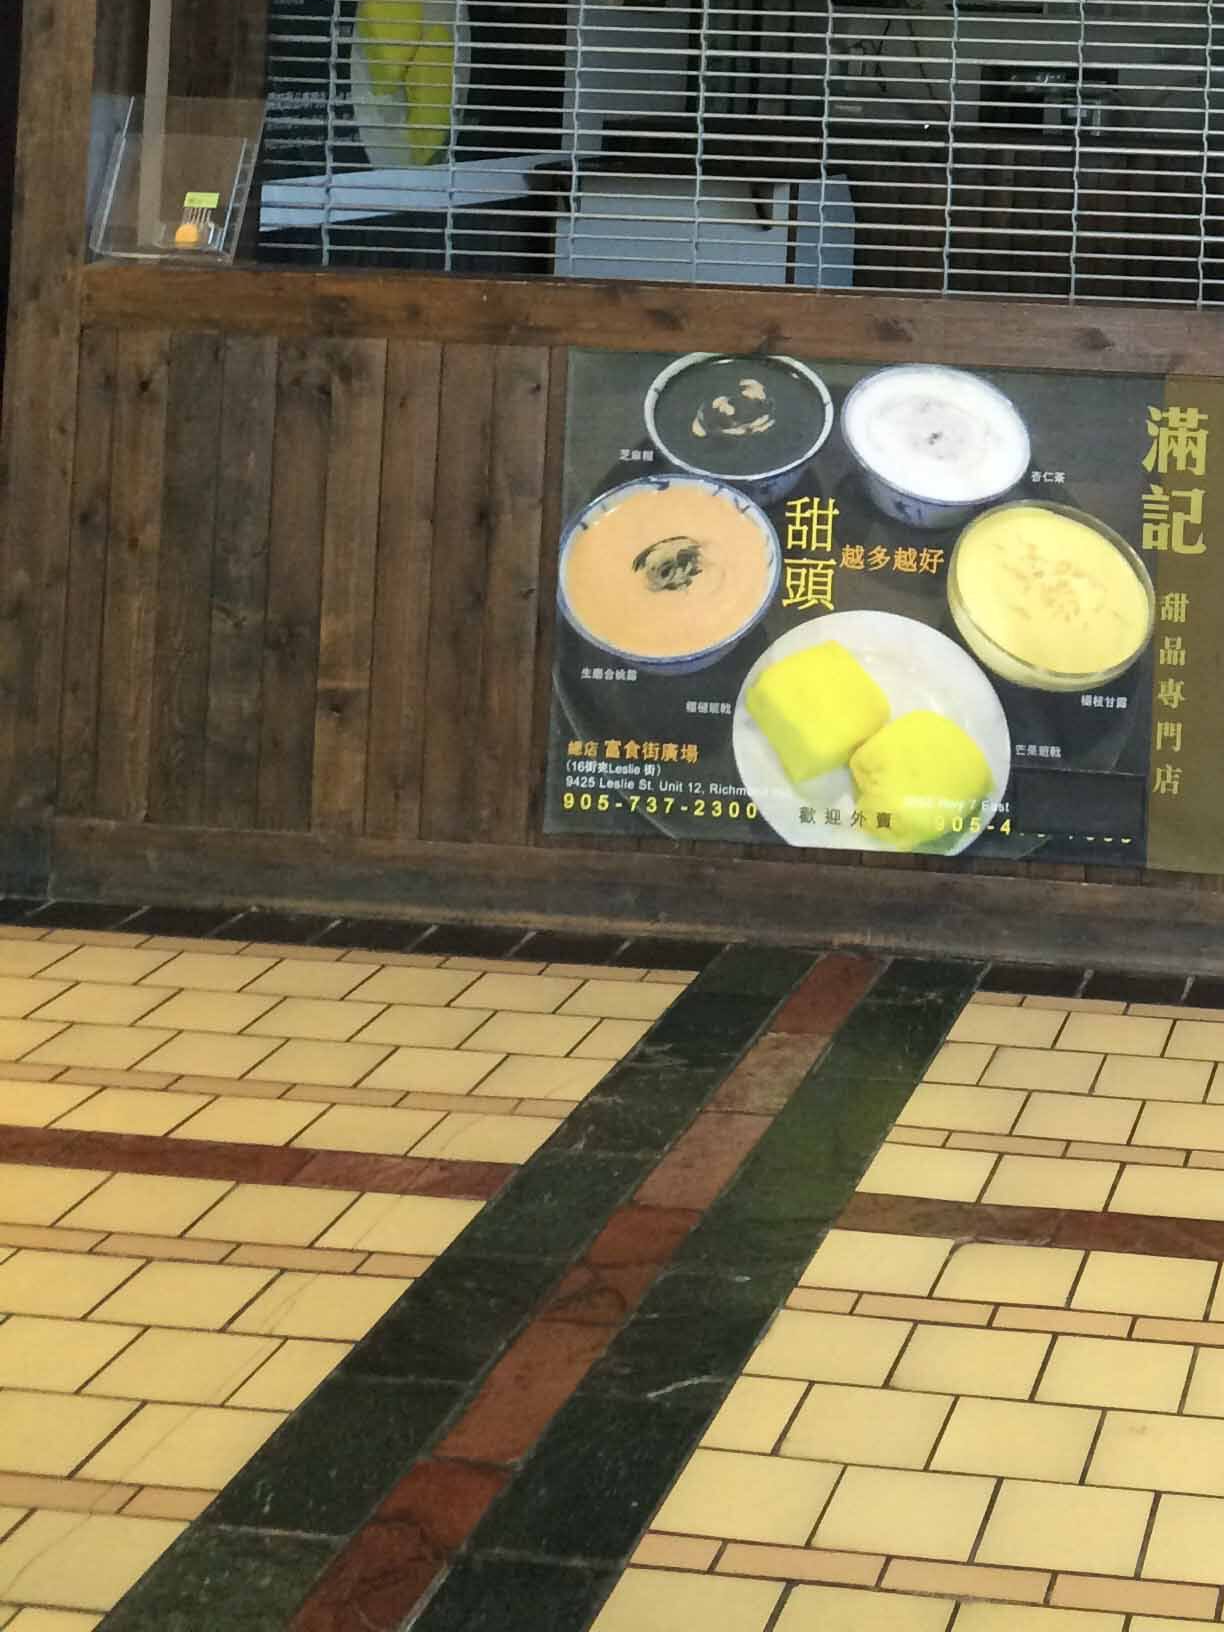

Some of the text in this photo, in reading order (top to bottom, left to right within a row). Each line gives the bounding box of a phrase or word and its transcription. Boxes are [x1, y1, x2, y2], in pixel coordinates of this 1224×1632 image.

[1141, 404, 1210, 555] 滿記
[781, 495, 841, 611] 甜頭
[839, 543, 946, 576] 越多越好
[1151, 591, 1191, 796] 甜品專門店
[565, 775, 597, 789] 9425
[599, 776, 636, 790] Leslie
[659, 780, 684, 794] Unit
[687, 782, 706, 796] 12,
[562, 792, 758, 820] 905-737-2300
[799, 805, 893, 831] 歡迎外賣
